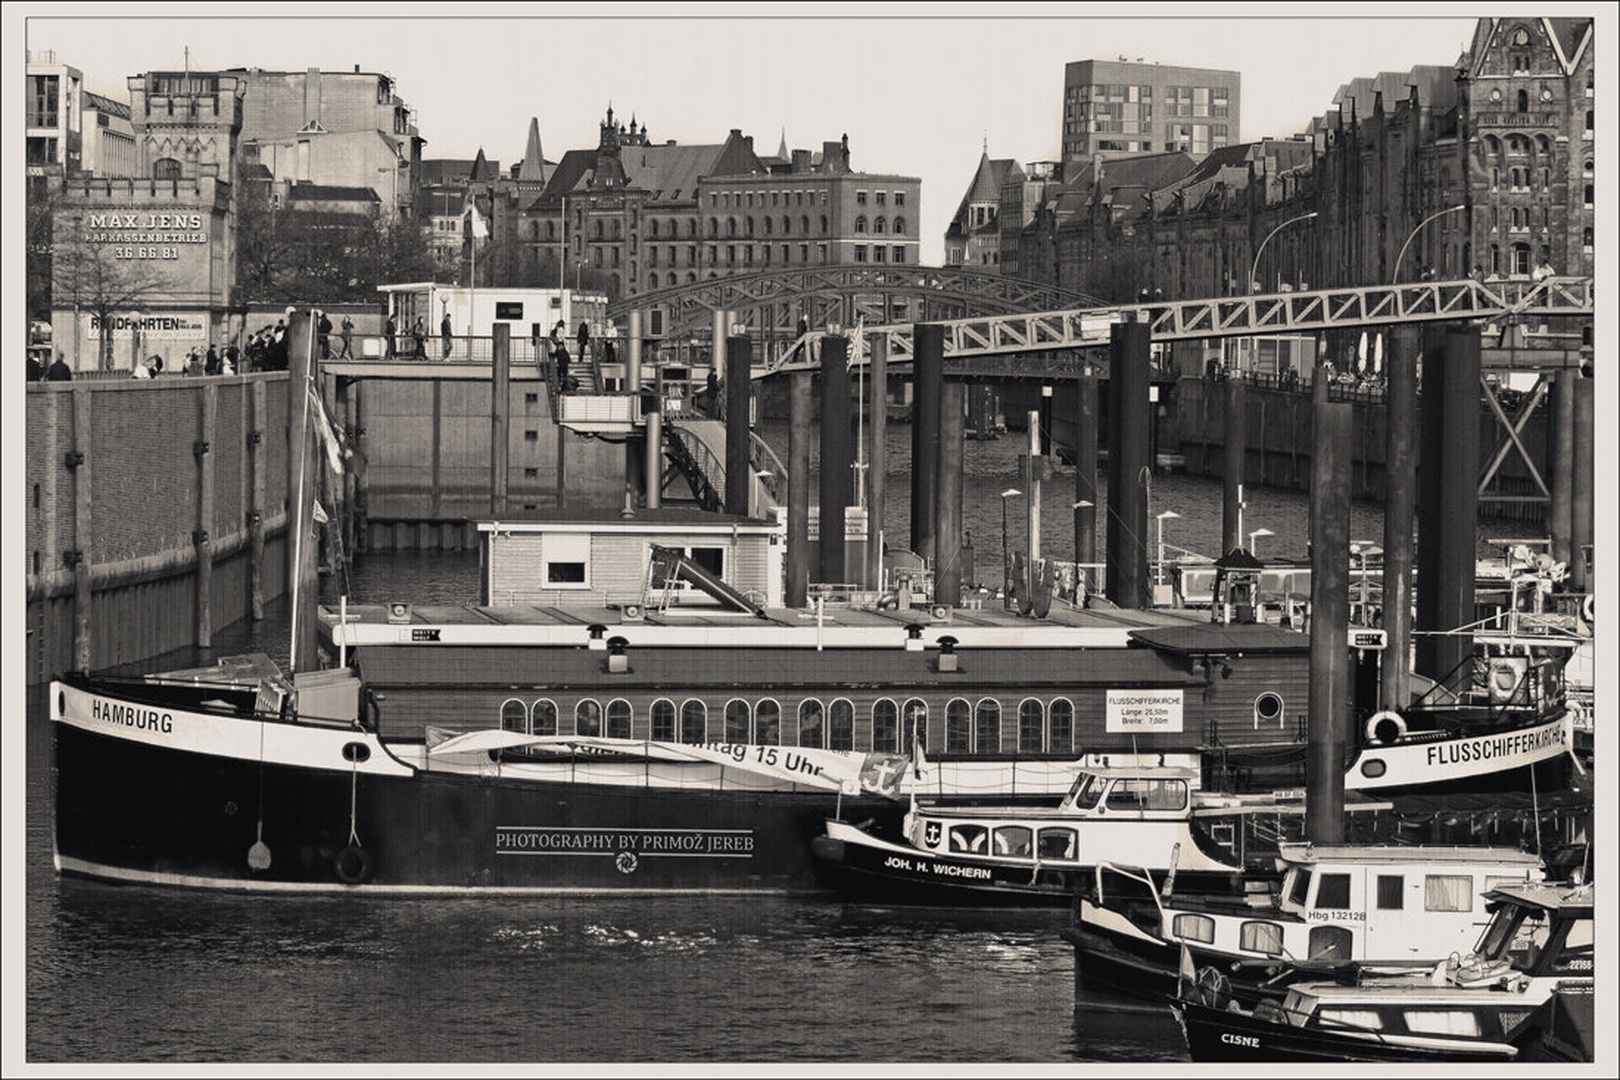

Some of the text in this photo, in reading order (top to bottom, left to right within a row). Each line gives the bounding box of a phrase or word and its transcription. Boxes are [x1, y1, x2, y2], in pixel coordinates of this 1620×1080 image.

[90, 215, 201, 229] MAX JENS
[115, 247, 178, 259] 36 66 81
[93, 699, 173, 733] HAMBURG
[756, 746, 779, 766] 15
[785, 752, 824, 776] Uhr
[884, 857, 991, 879] JOH. H. WICHERN
[1308, 911, 1329, 921] Hbg
[1220, 1033, 1260, 1048] CISNE
